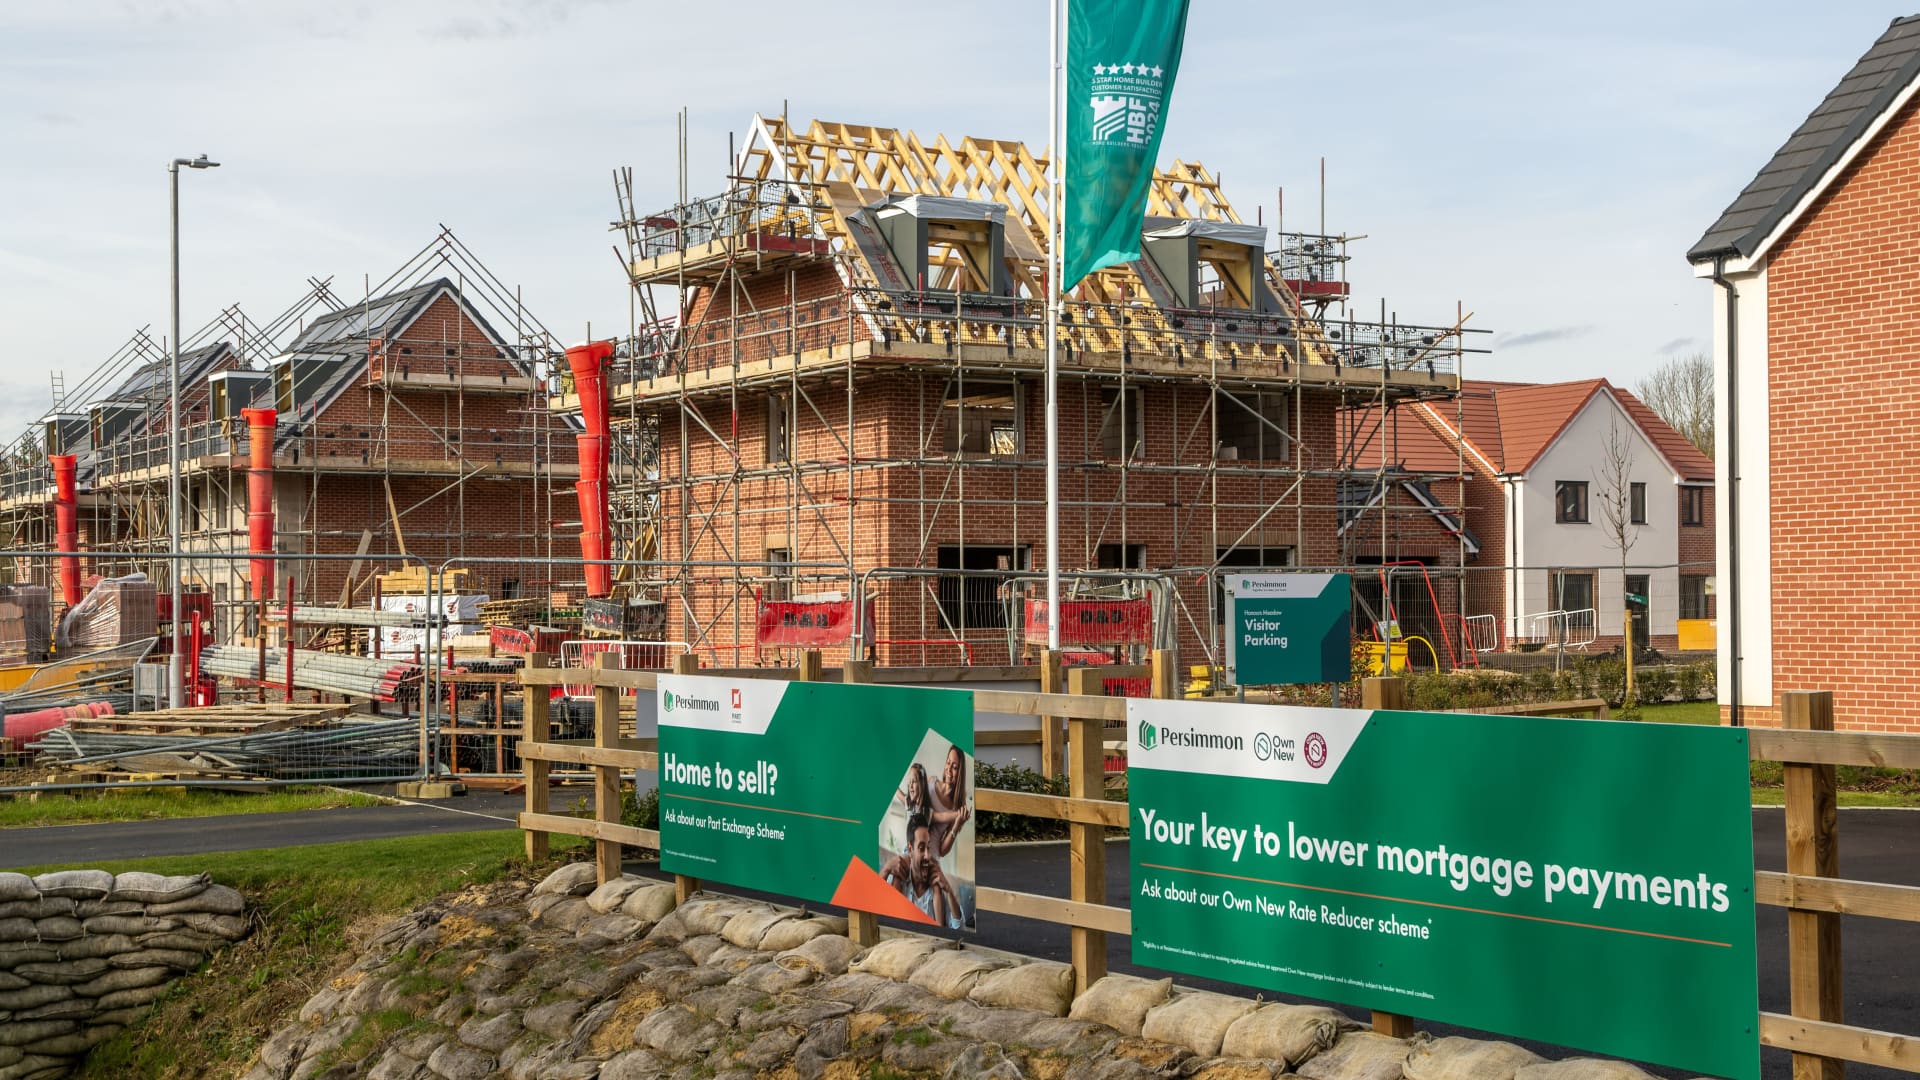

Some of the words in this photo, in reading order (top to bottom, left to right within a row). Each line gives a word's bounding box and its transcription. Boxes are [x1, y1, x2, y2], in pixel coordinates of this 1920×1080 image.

[1123, 85, 1162, 96] SATISFACTION
[1135, 78, 1163, 88] BUILDER
[1126, 97, 1147, 144] HBF
[1244, 618, 1280, 631] Visitor
[1244, 633, 1288, 648] Parking
[675, 694, 720, 712] Persimmon
[1161, 727, 1243, 752] Persimmon
[1272, 735, 1295, 749] Own
[1274, 748, 1295, 761] New
[664, 752, 711, 788] Home
[715, 764, 733, 790] to
[737, 760, 778, 796] sell?
[665, 808, 675, 822] Ask
[677, 810, 695, 826] about
[696, 818, 706, 828] our
[708, 816, 721, 830] Part
[722, 818, 755, 839] Exchange
[1139, 808, 1194, 845] Your
[1201, 812, 1247, 862] key
[1254, 824, 1281, 856] to
[1288, 821, 1368, 867] lower
[1377, 842, 1534, 897] mortgage
[1544, 864, 1730, 912] payments
[1141, 878, 1161, 898] Ask
[1164, 881, 1197, 903] about
[1200, 892, 1219, 907] our
[1223, 890, 1252, 912] Own
[1256, 894, 1285, 917] New
[1289, 900, 1317, 922] Rate
[1321, 905, 1374, 931] Reducer
